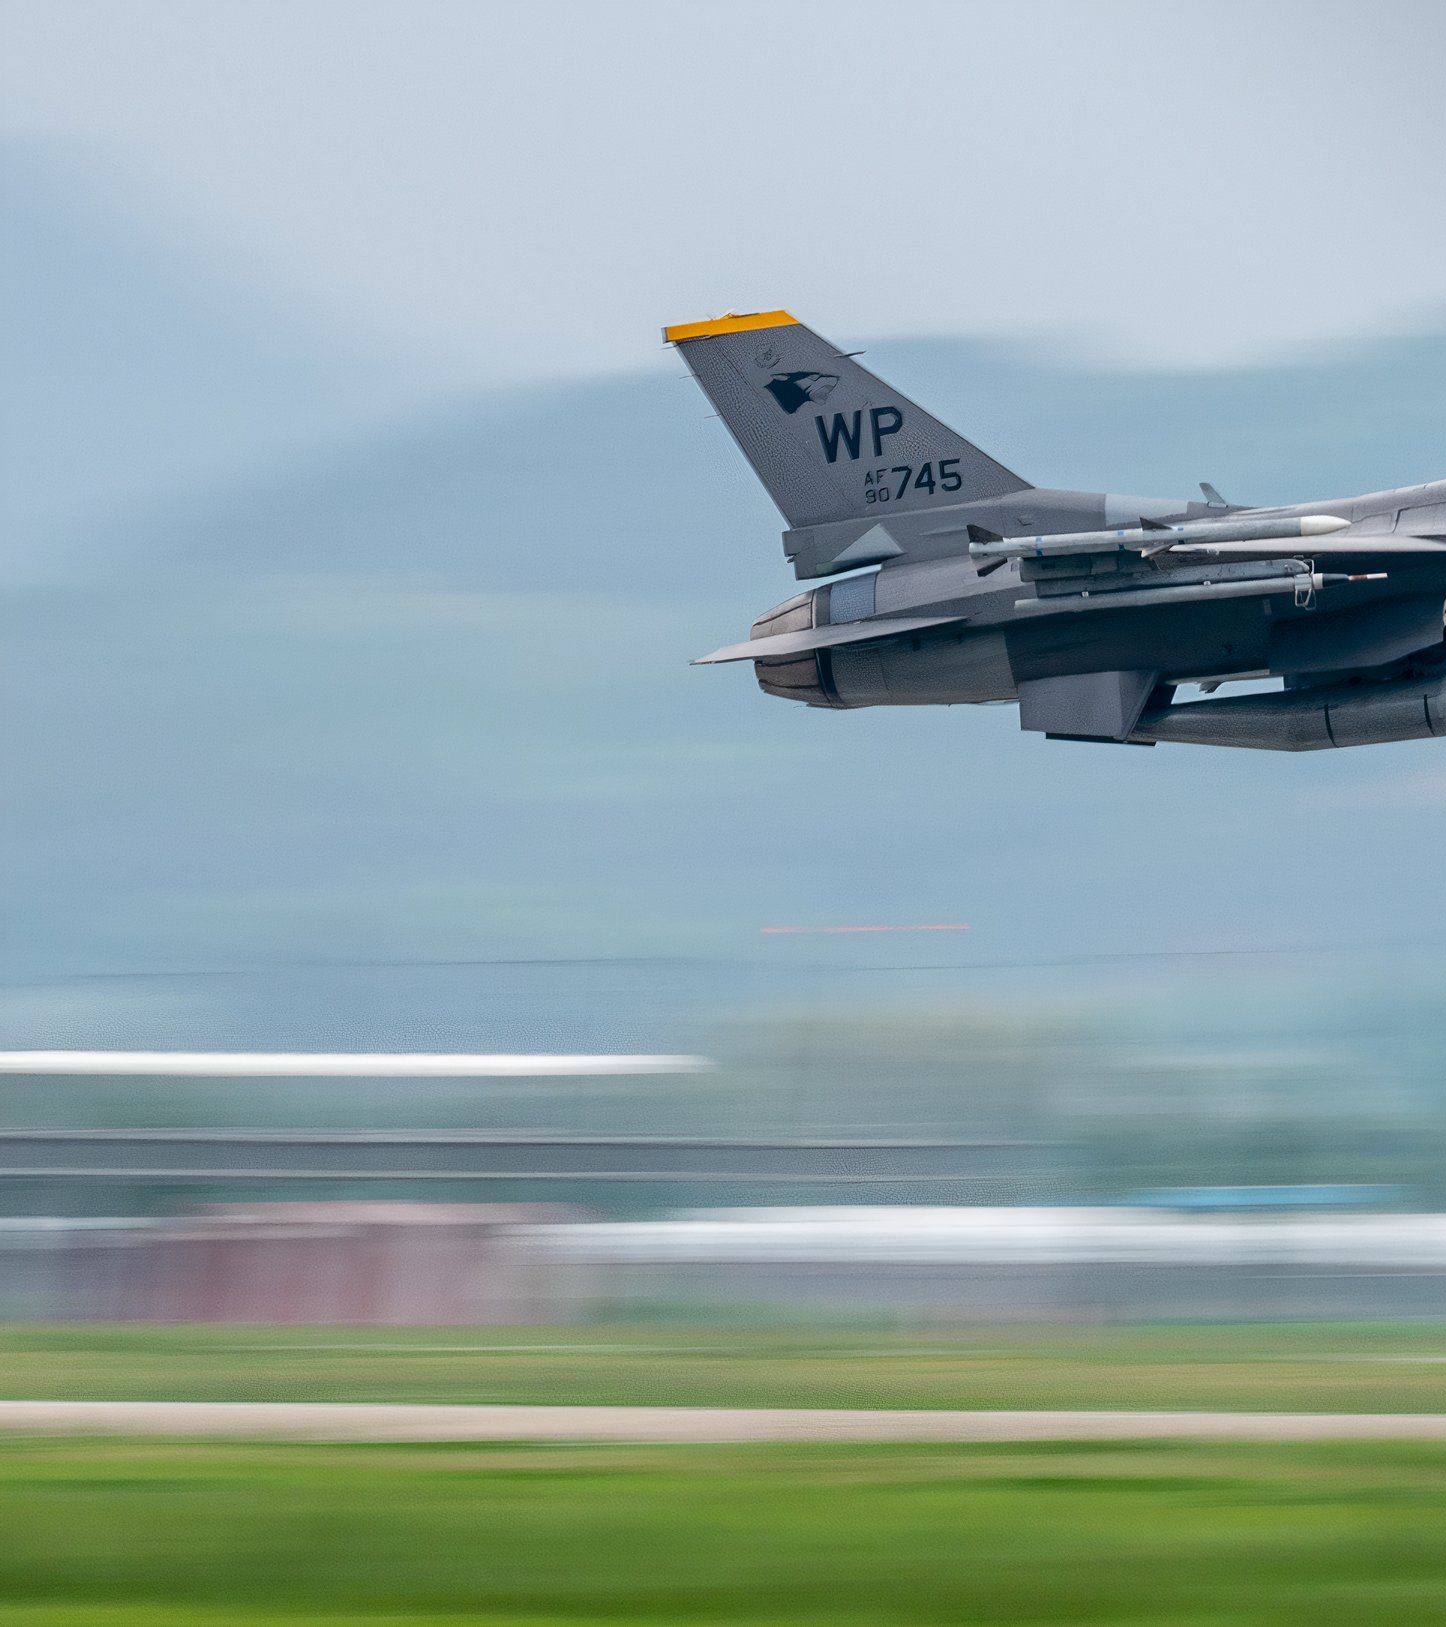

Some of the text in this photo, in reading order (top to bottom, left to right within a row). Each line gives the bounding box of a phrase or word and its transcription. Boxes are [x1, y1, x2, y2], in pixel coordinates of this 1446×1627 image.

[815, 406, 903, 464] WP
[864, 468, 888, 486] AF
[891, 458, 962, 500] 745
[865, 487, 890, 504] 90
